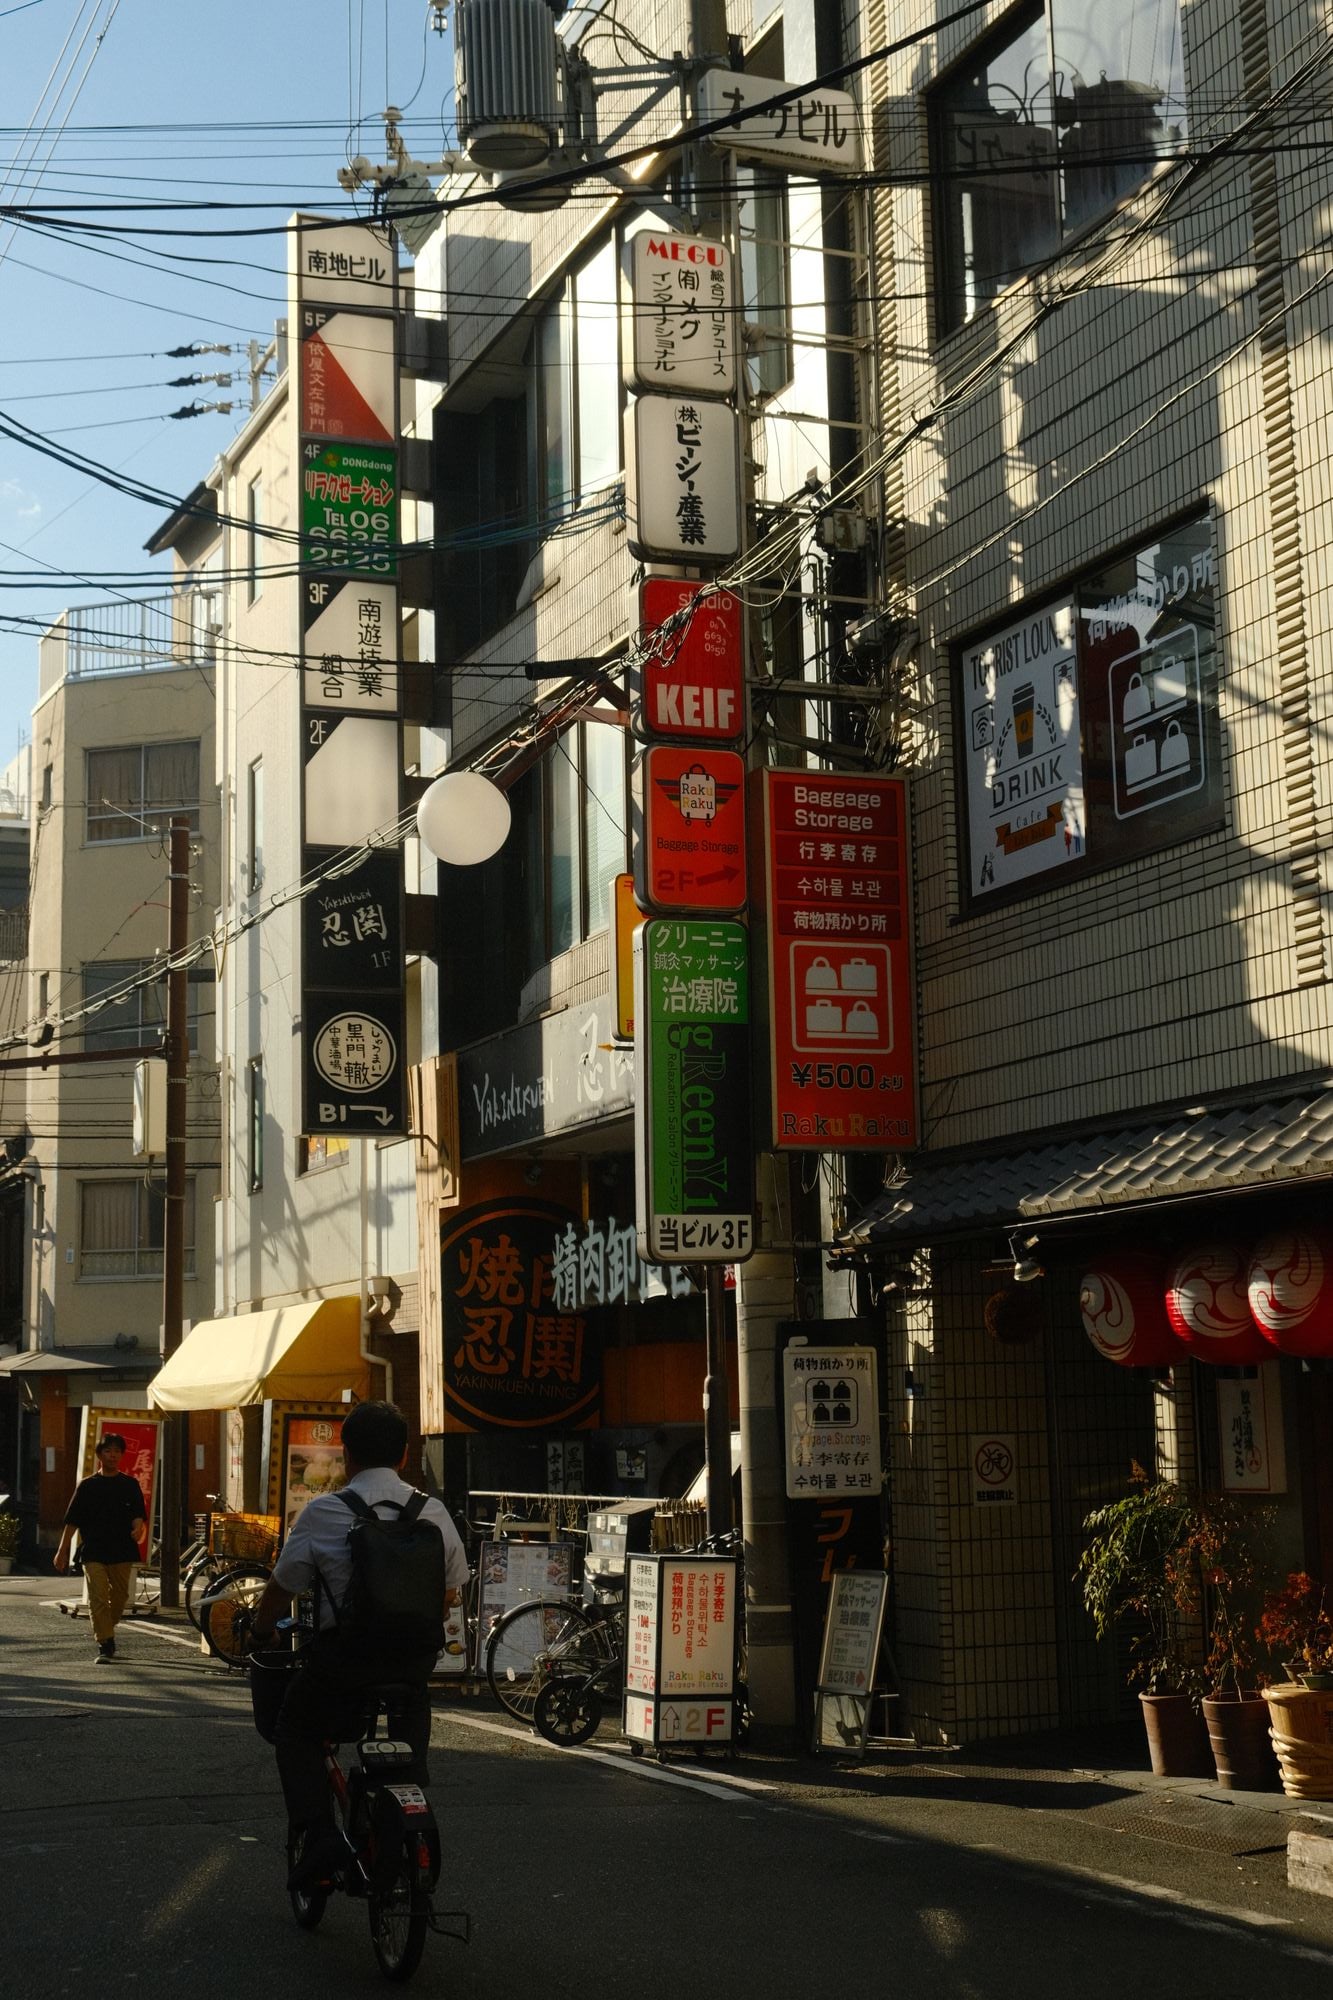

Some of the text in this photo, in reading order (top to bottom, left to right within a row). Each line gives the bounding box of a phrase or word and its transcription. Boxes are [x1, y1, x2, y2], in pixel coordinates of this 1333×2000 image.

[646, 238, 724, 267] MEGU
[308, 250, 386, 281] 南地ビル
[305, 311, 326, 327] 5F
[304, 444, 320, 459] 4F
[342, 457, 392, 472] DONGdong
[305, 470, 394, 508] リラクゼーション
[323, 507, 390, 531] TEL 06
[309, 547, 390, 571] 2525
[309, 582, 329, 605] 3F
[357, 598, 383, 697] 南遊技業
[970, 632, 1020, 690] TORIST
[656, 682, 736, 729] KEIF
[310, 719, 328, 745] 2F
[681, 782, 715, 797] Raku
[993, 755, 1063, 809] DRINK
[682, 796, 715, 811] Raku
[794, 785, 881, 810] Baggage
[795, 809, 873, 831] Storage
[1016, 810, 1042, 829] Cafe
[657, 837, 739, 854] Baggage Storage
[799, 841, 877, 863] 行李寄存
[657, 870, 694, 891] 2F
[797, 877, 882, 899] 수하물 보관
[793, 910, 887, 932] 荷物預かり所
[656, 924, 743, 949] グリーニー
[370, 950, 391, 969] 1F
[654, 951, 745, 971] 鍼灸マッサージ
[662, 975, 739, 1014] 治療院
[668, 1115, 678, 1148] Salon
[782, 1113, 911, 1137] Raku Raku
[659, 1217, 749, 1253] 当ビル3F
[793, 1357, 869, 1371] 荷物預かり所
[834, 1432, 871, 1445] Storage
[794, 1473, 873, 1489] 수하물 보관
[671, 1572, 684, 1635] 荷物預かり
[697, 1573, 709, 1647] 수하물위탁소
[685, 1573, 696, 1659] Baggage Storage
[669, 1669, 723, 1681] Raku Raku
[686, 1705, 725, 1736] 2F
